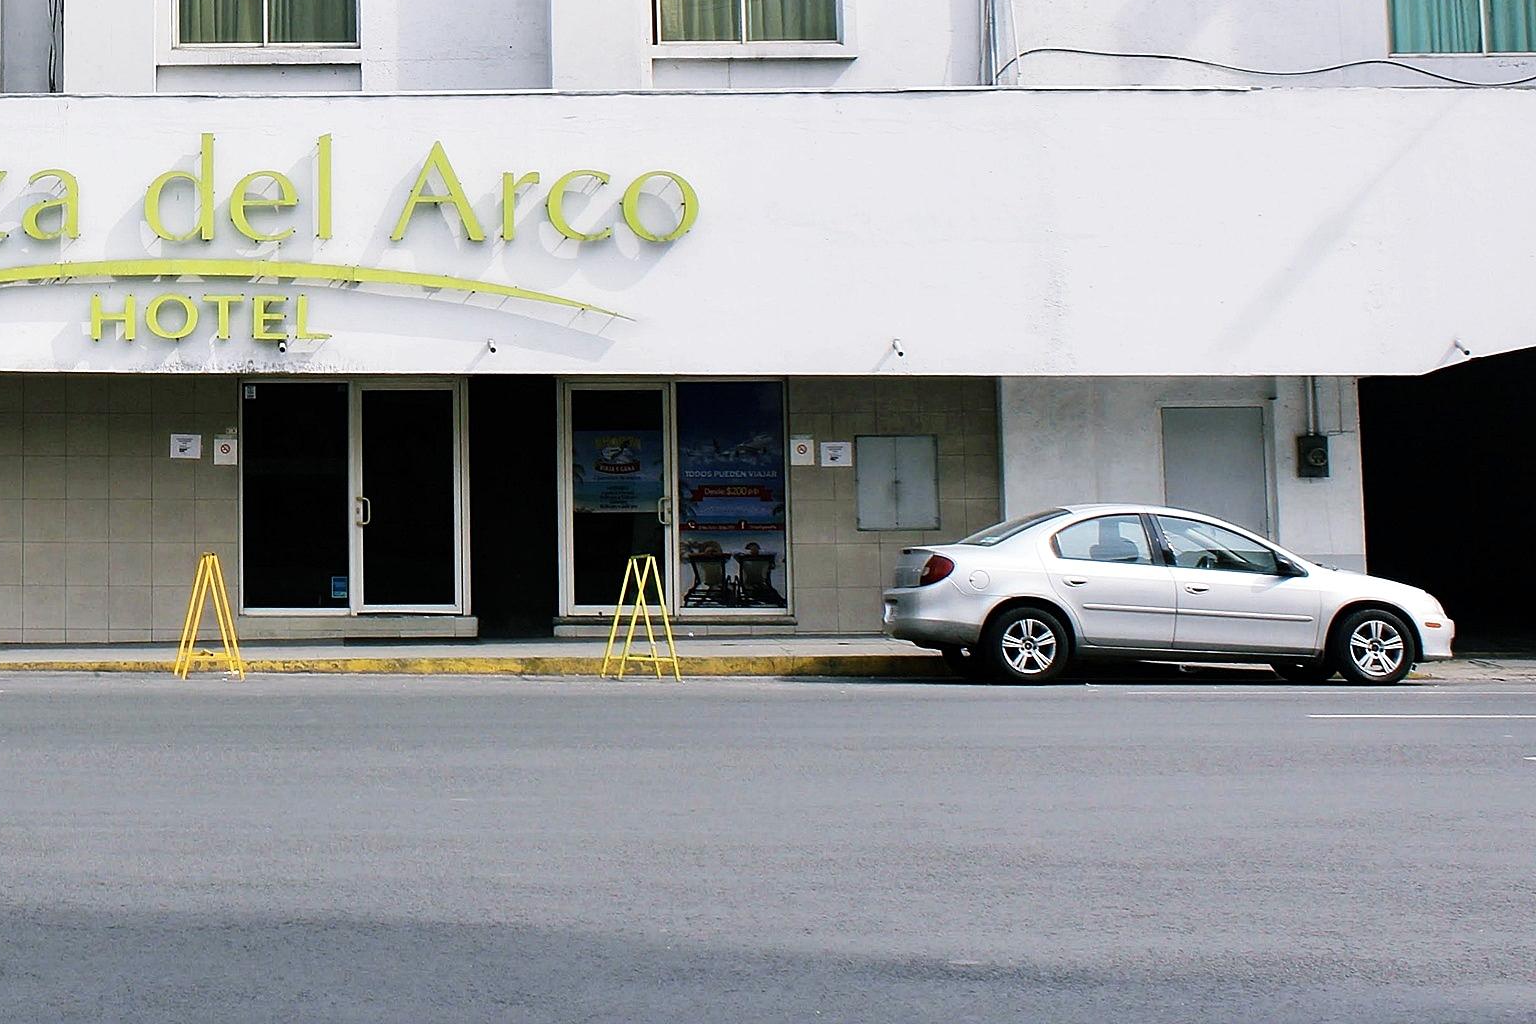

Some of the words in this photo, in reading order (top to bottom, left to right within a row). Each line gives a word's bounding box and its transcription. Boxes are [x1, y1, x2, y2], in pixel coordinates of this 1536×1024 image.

[144, 132, 332, 242] del
[389, 140, 700, 242] Arco
[90, 293, 332, 341] HOTEL
[684, 470, 713, 478] TODOS
[714, 470, 746, 478] PUEDEN
[747, 470, 777, 478] VIAJAR
